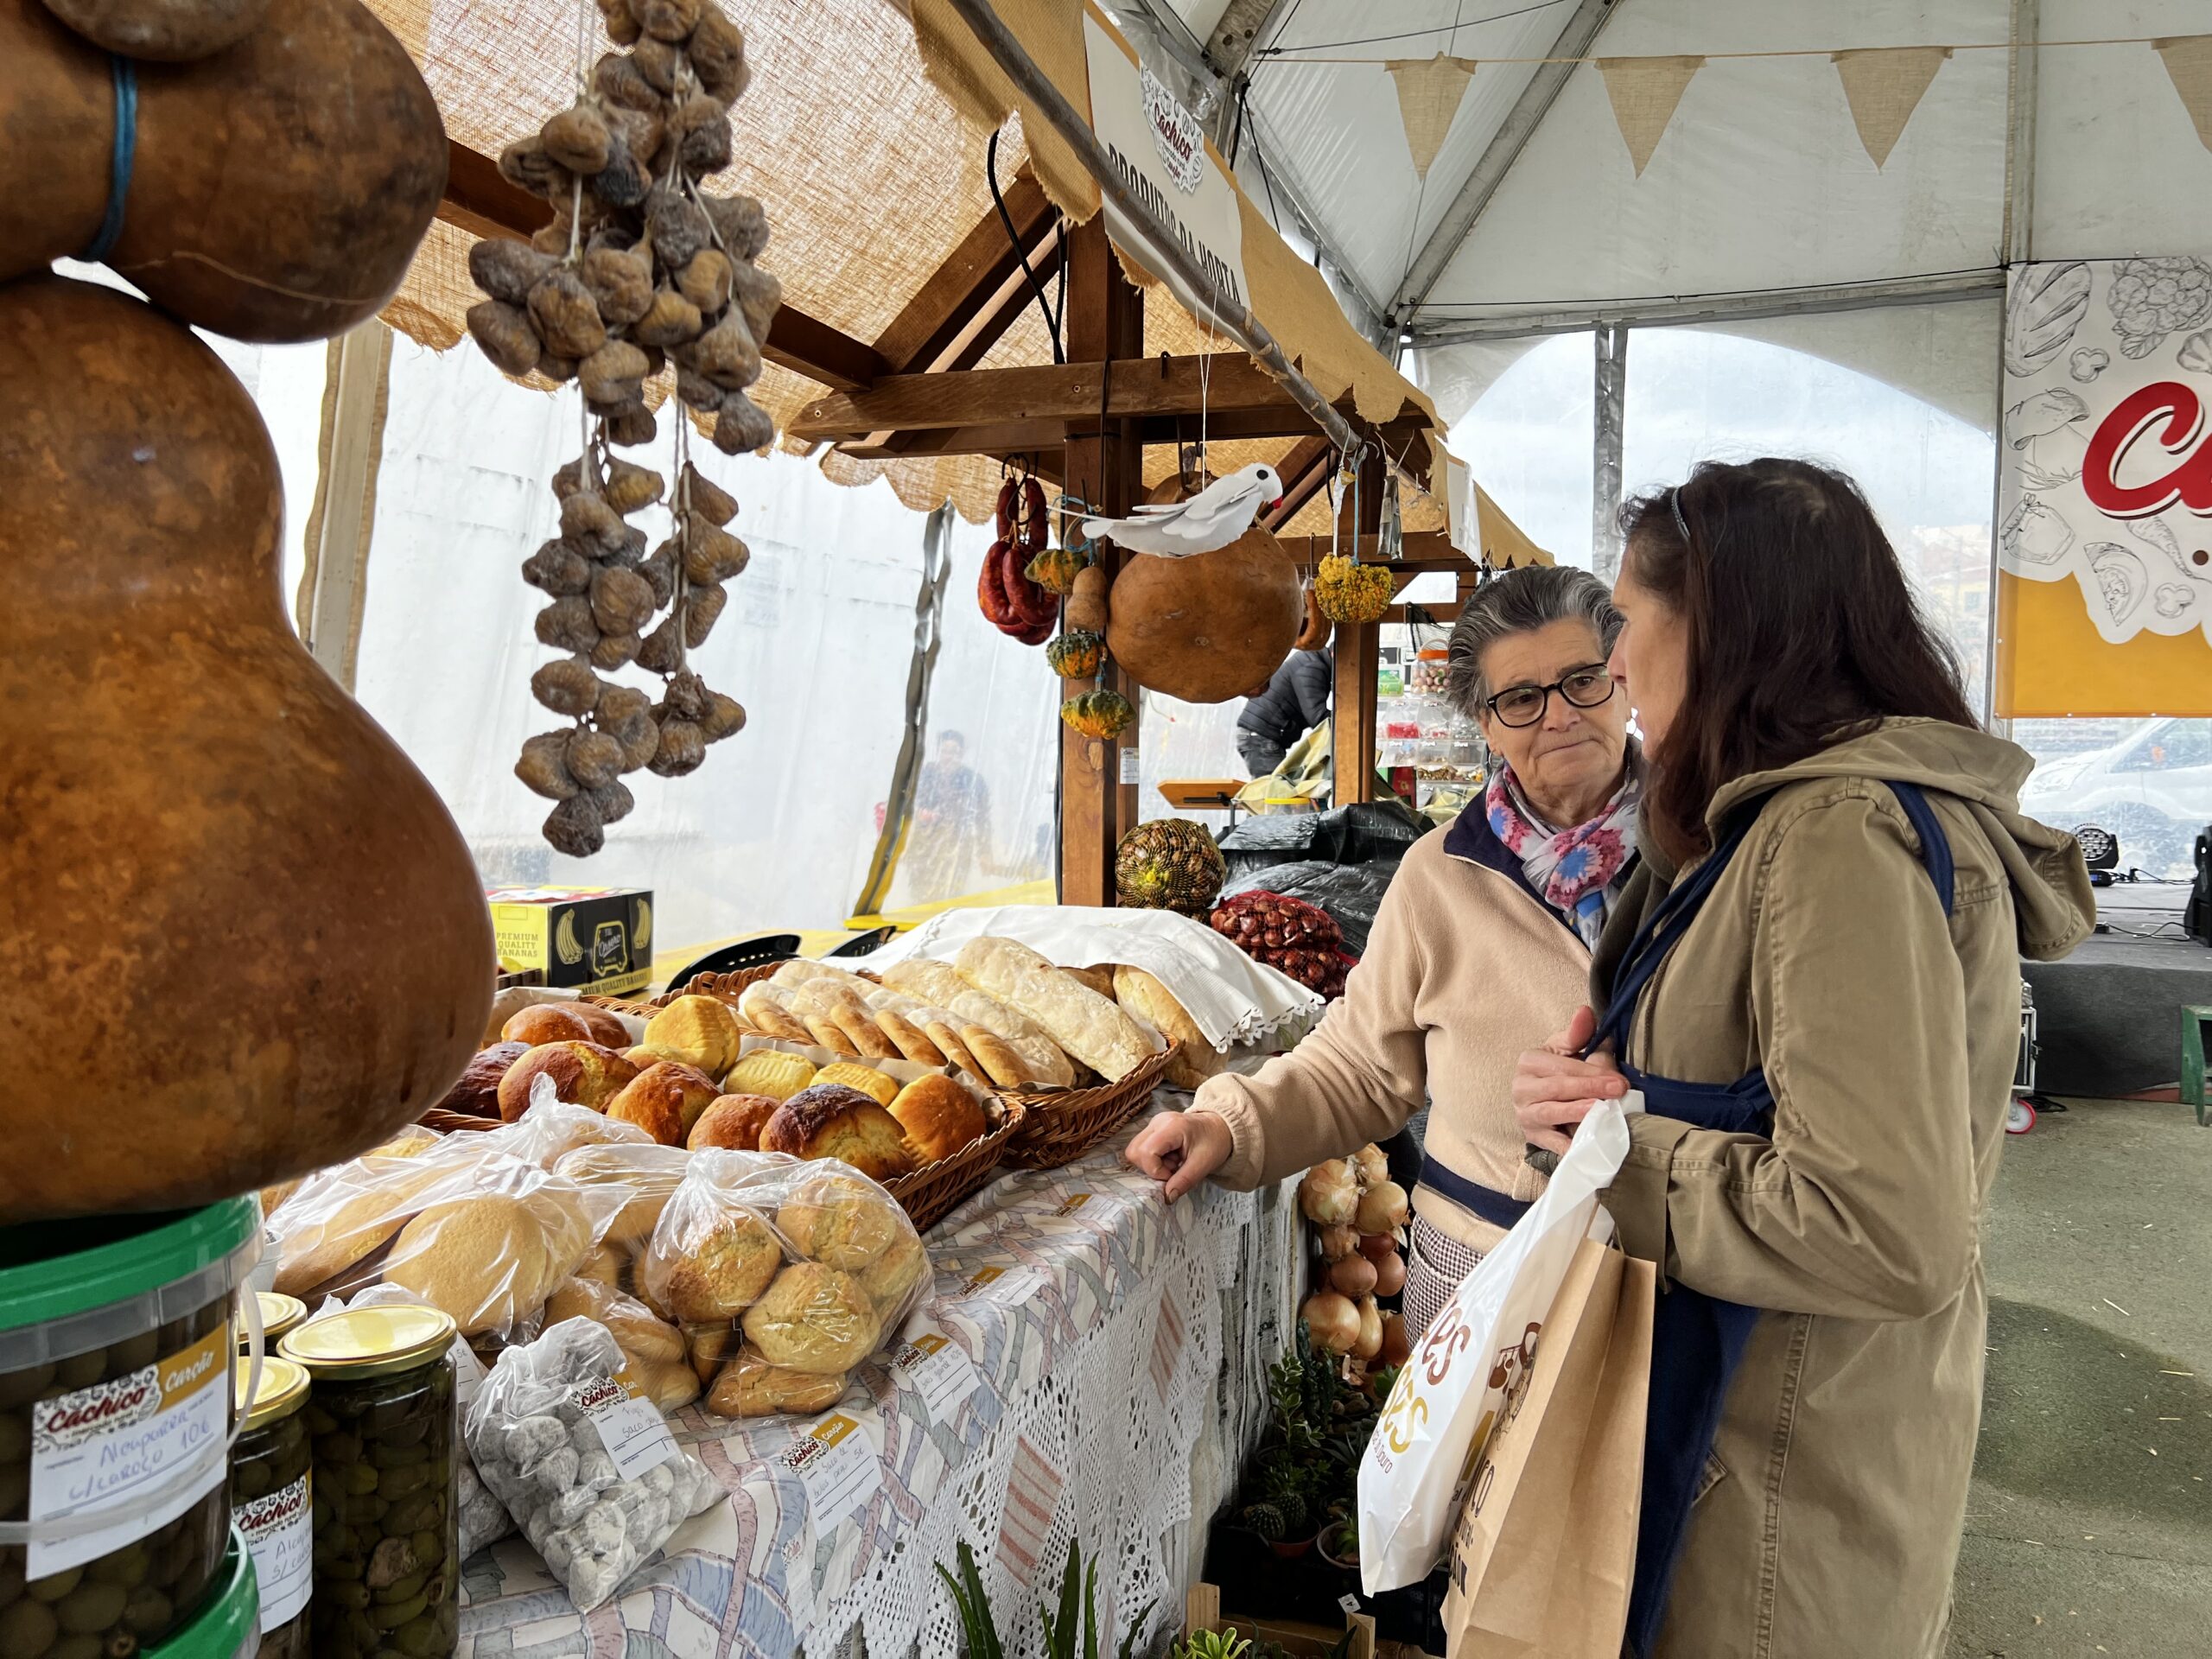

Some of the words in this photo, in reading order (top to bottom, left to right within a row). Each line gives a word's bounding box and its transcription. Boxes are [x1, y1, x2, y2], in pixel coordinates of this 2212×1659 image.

[1154, 102, 1192, 162] Cachico
[496, 932, 539, 942] PREMIUM
[498, 941, 537, 950] QUALITY
[165, 1351, 215, 1393] Carção
[47, 1387, 149, 1433] Cachico
[581, 1384, 619, 1409] Cachico
[788, 1440, 819, 1467] Cachico
[238, 1491, 302, 1533] Cachico
